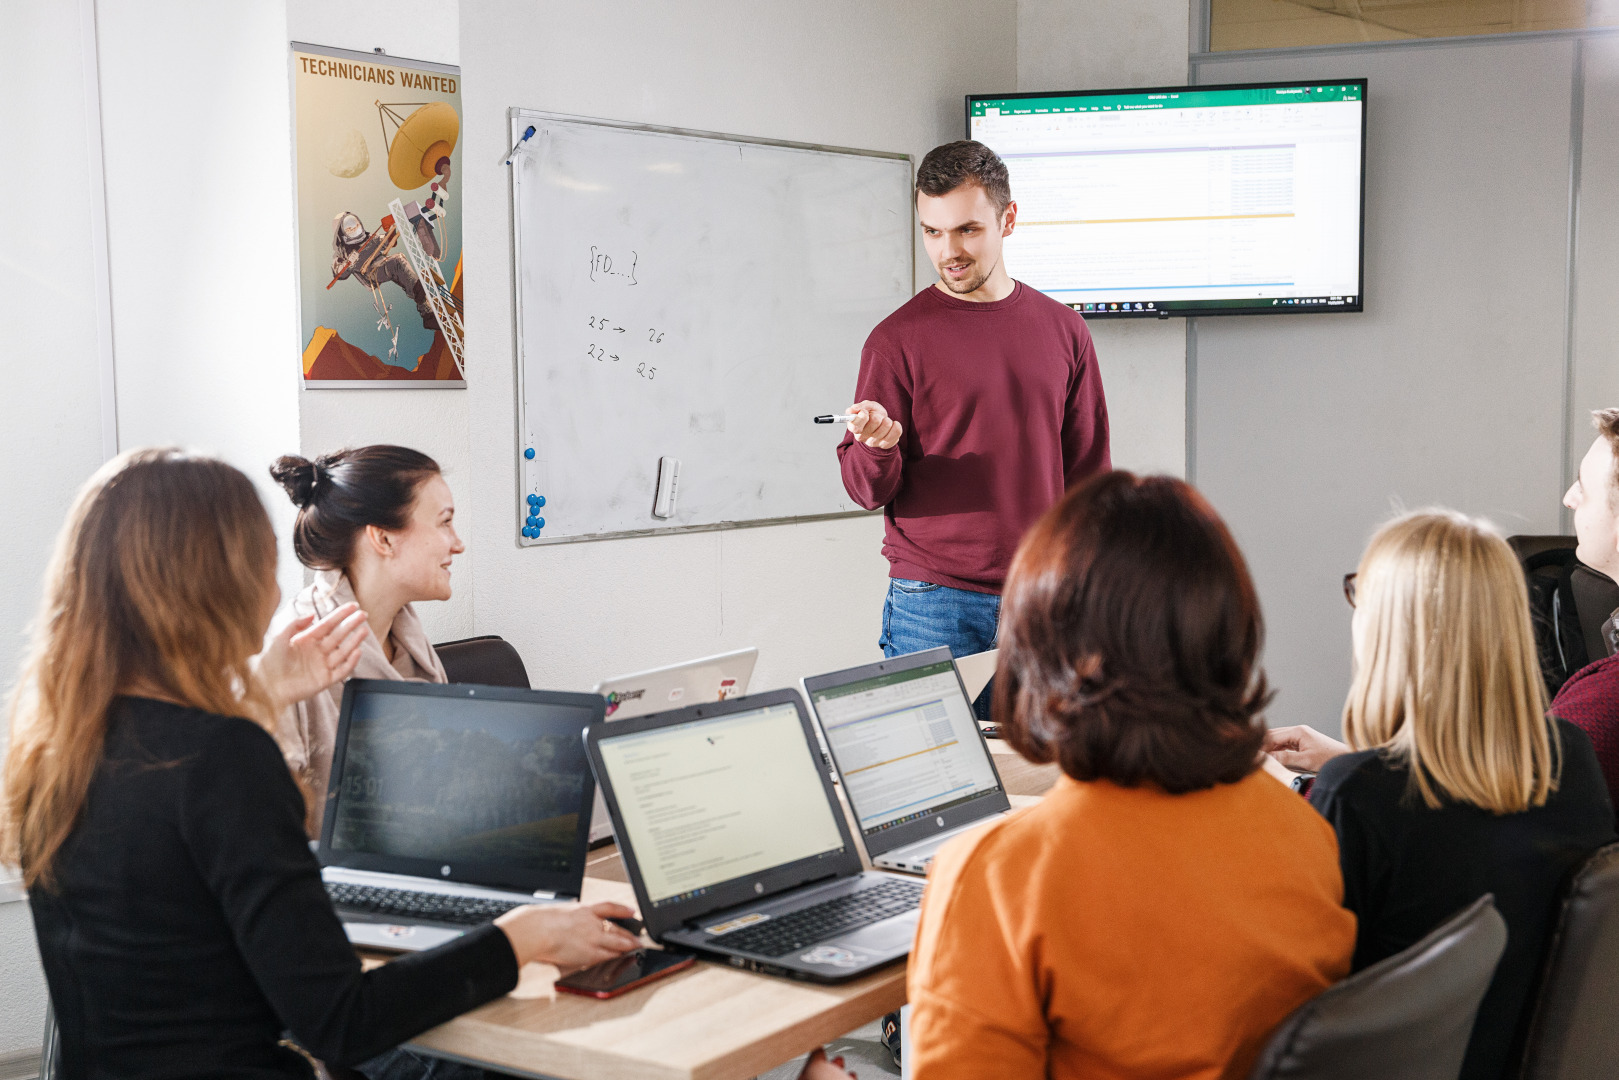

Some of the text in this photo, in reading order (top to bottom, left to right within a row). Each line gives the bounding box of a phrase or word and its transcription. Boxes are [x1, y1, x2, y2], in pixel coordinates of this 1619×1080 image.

[300, 57, 457, 94] TECHNICIANS WANTED
[589, 316, 665, 343] 25 26
[588, 344, 656, 380] 22 25
